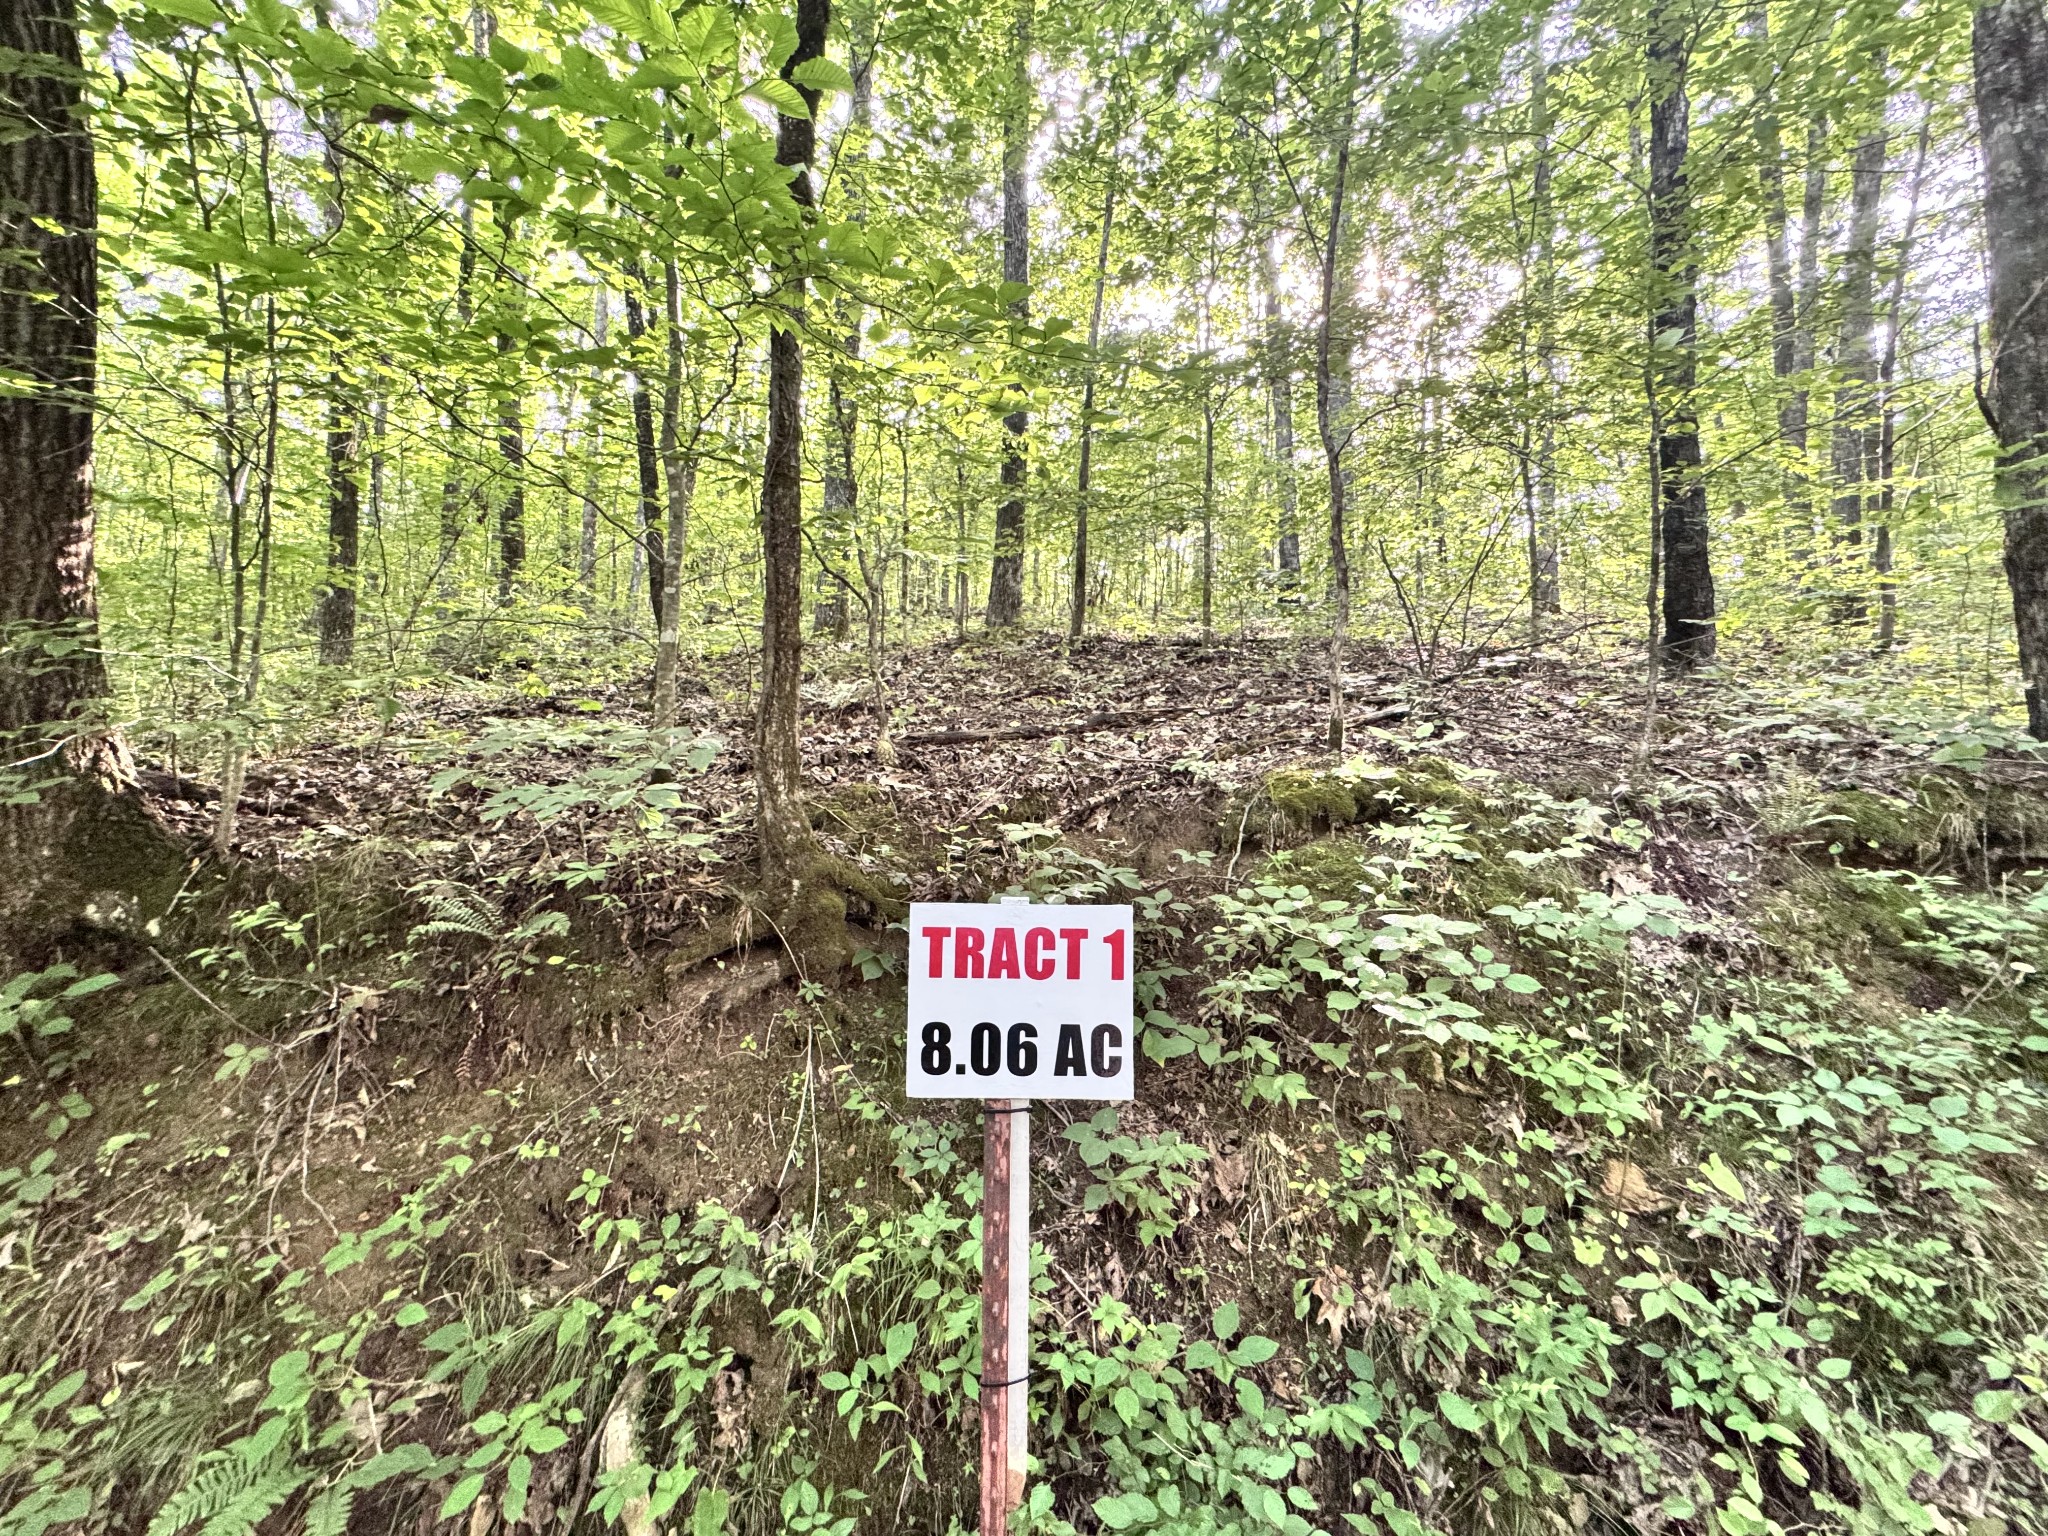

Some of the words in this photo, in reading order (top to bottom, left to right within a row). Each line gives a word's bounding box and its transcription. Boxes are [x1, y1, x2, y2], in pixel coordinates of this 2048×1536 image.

[922, 927, 1089, 980] TRACT
[1103, 929, 1125, 980] 1
[921, 1022, 1038, 1077] 8.06
[1054, 1023, 1123, 1078] AC
